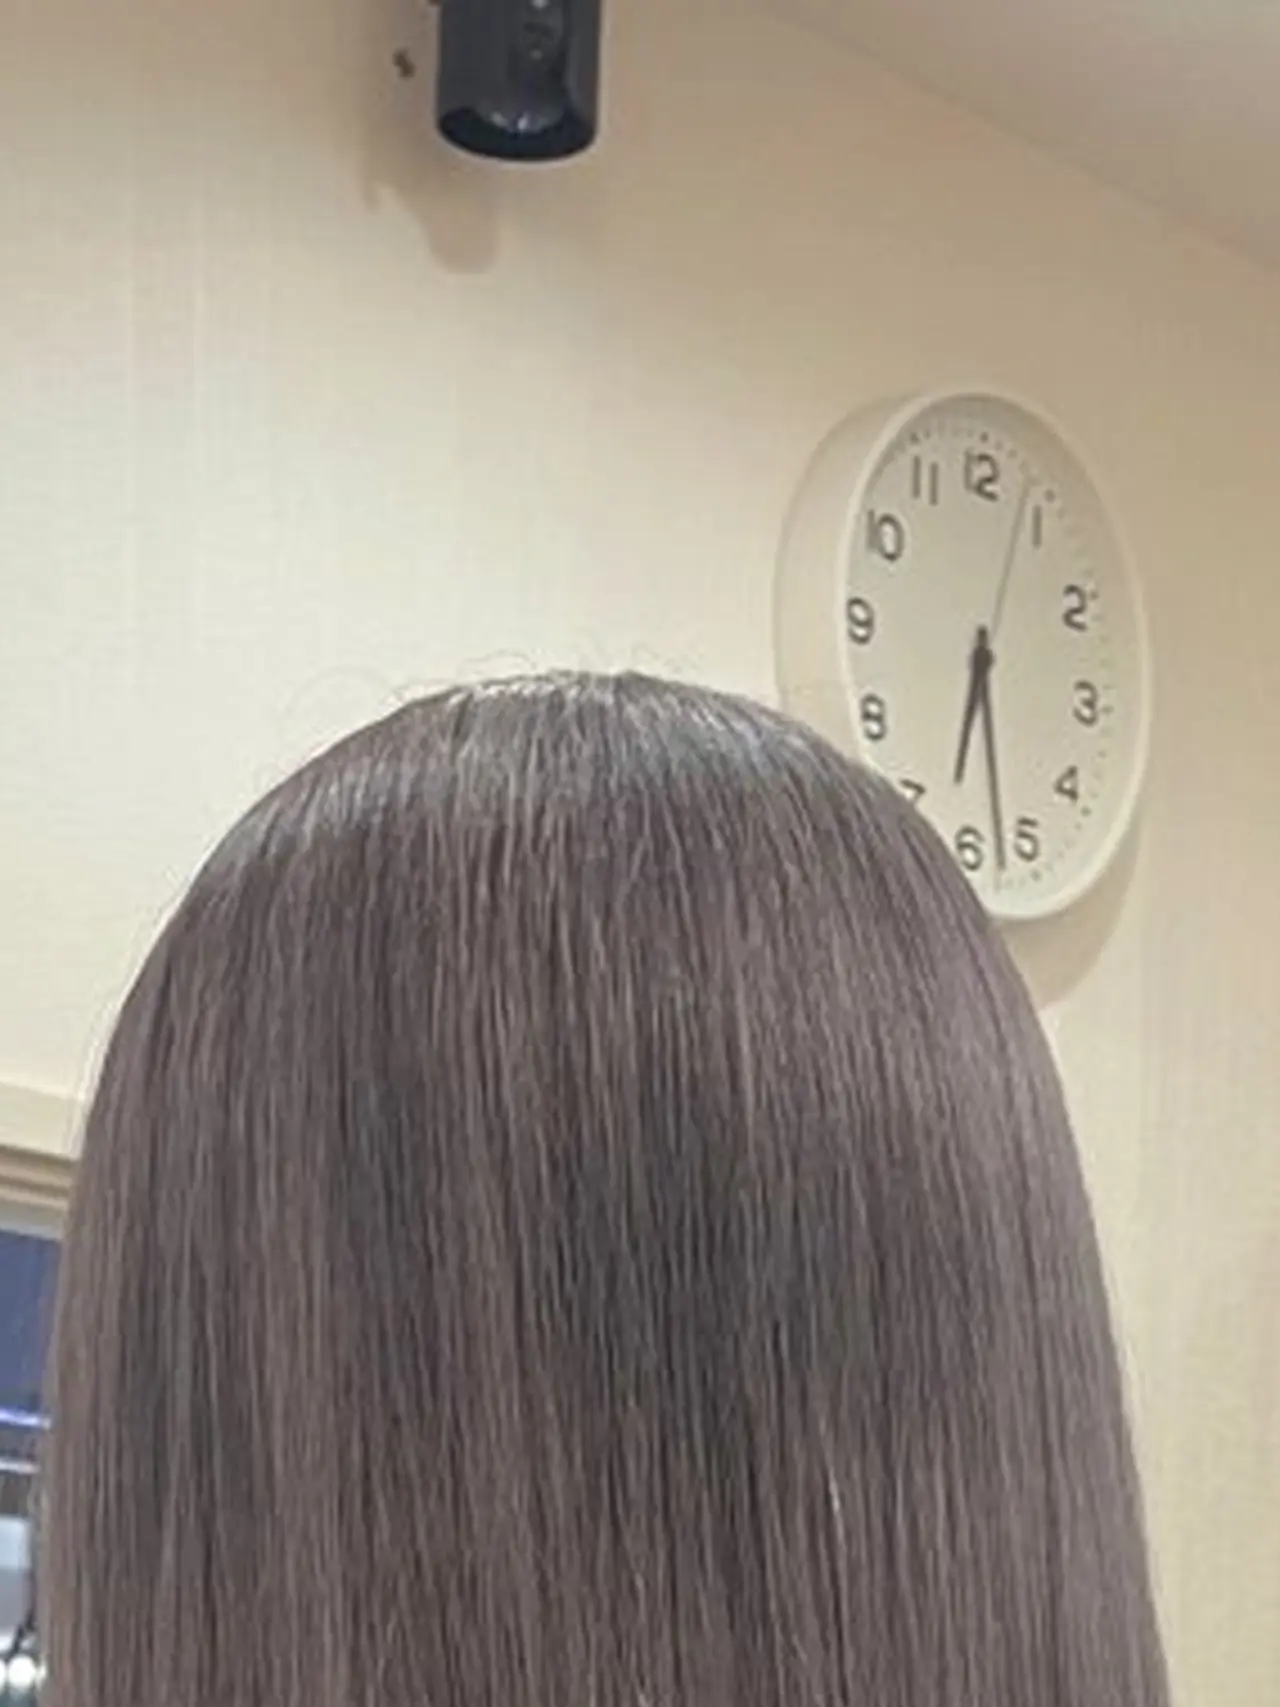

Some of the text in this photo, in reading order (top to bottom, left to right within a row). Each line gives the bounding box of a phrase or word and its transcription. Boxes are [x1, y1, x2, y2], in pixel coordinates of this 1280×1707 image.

[912, 455, 938, 506] 11
[963, 451, 1000, 502] 12
[866, 507, 904, 562] 10
[1030, 503, 1043, 549] 1
[846, 597, 875, 646] 9
[1061, 584, 1088, 632] 2
[860, 694, 888, 742] 8
[1072, 680, 1099, 727] 3
[1054, 765, 1080, 804] 4
[955, 826, 985, 872] 6
[1014, 817, 1041, 863] 5
